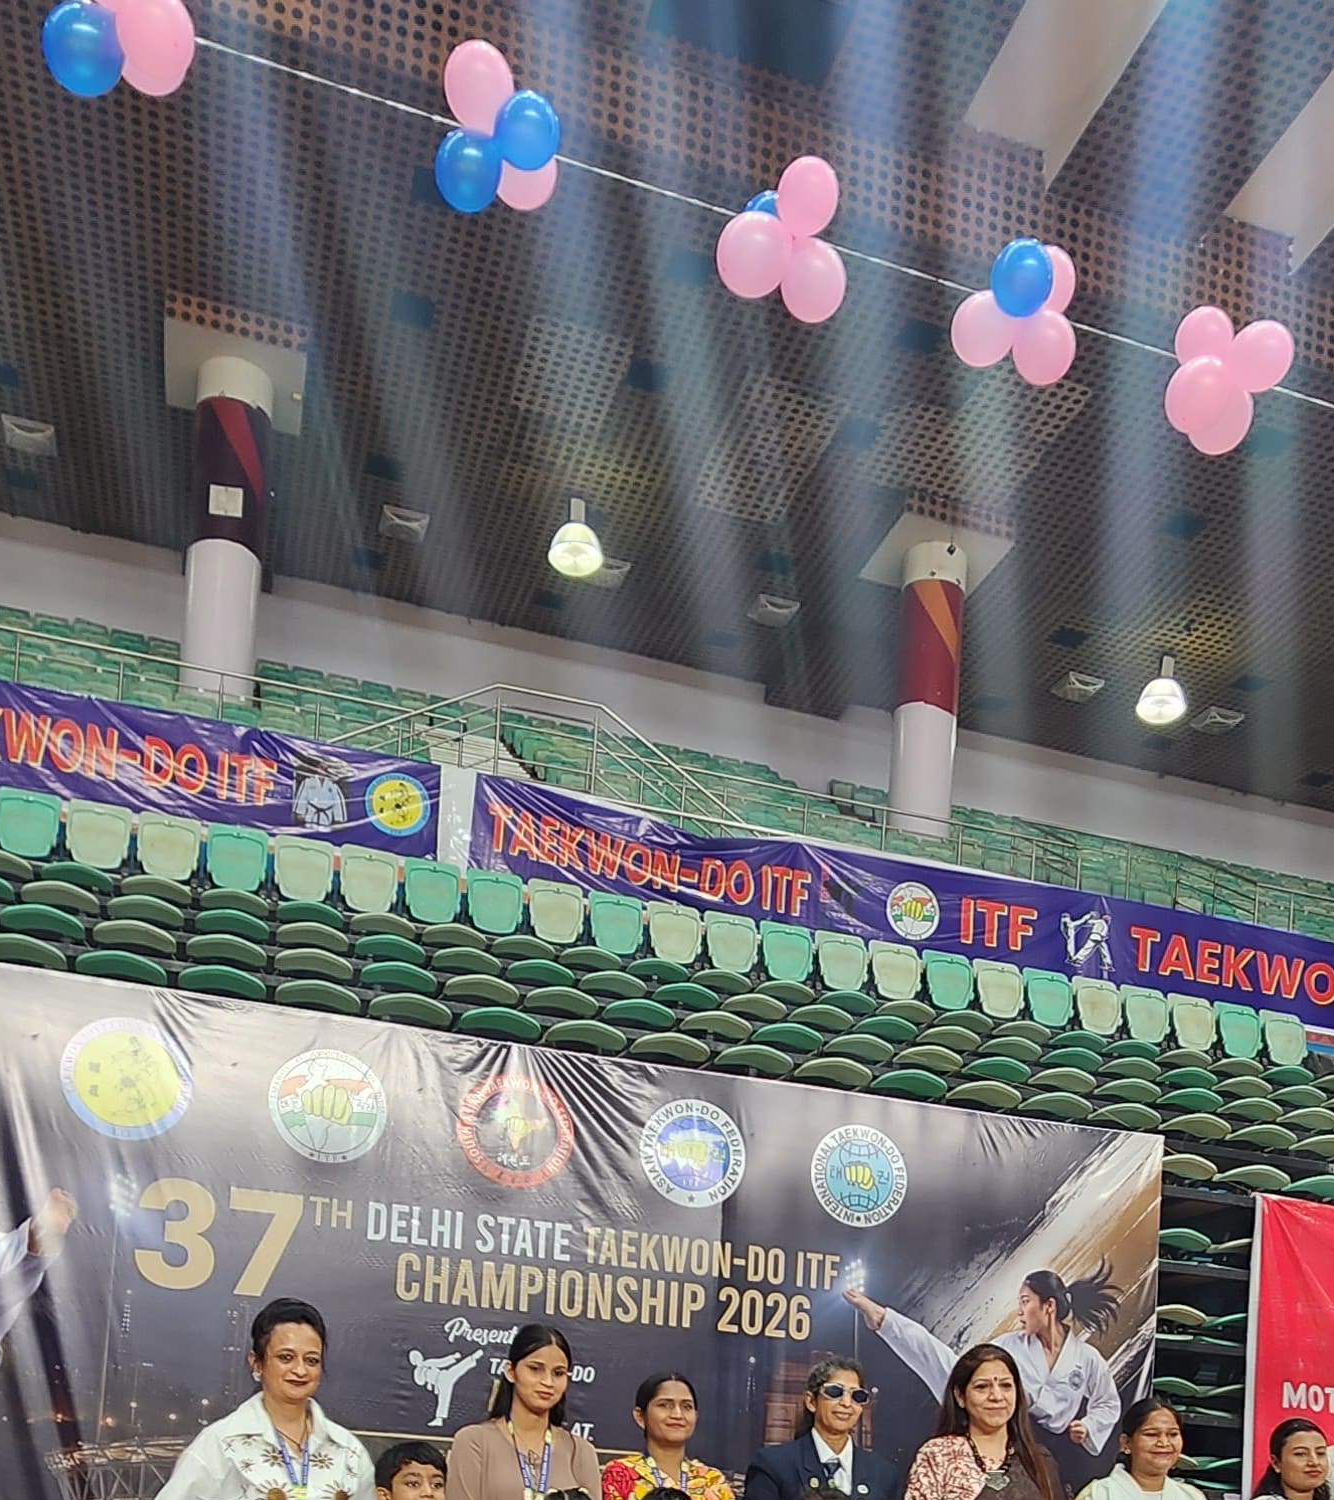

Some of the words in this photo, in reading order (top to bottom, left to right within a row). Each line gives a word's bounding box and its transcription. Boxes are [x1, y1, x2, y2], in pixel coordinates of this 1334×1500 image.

[216, 752, 278, 806] ITF
[487, 802, 754, 905] TAEKWON-DO
[761, 864, 812, 917] ITF
[959, 896, 1038, 950] ITF
[644, 1103, 721, 1150] TAEKWON-DO
[830, 1127, 901, 1165] TAEKWON-DO
[643, 1154, 675, 1195] ASIAN
[708, 1119, 743, 1202] FEDERATION
[814, 1144, 856, 1225] INTERNATIONAL
[863, 1166, 906, 1226] FEDERATION
[367, 1201, 464, 1250] DELHI
[475, 1214, 571, 1262] STATE
[583, 1227, 786, 1285] TAEKWON-DO
[795, 1251, 842, 1290] ITF
[395, 1252, 706, 1329] CHAMPIONSHIP
[716, 1286, 813, 1341] 2026
